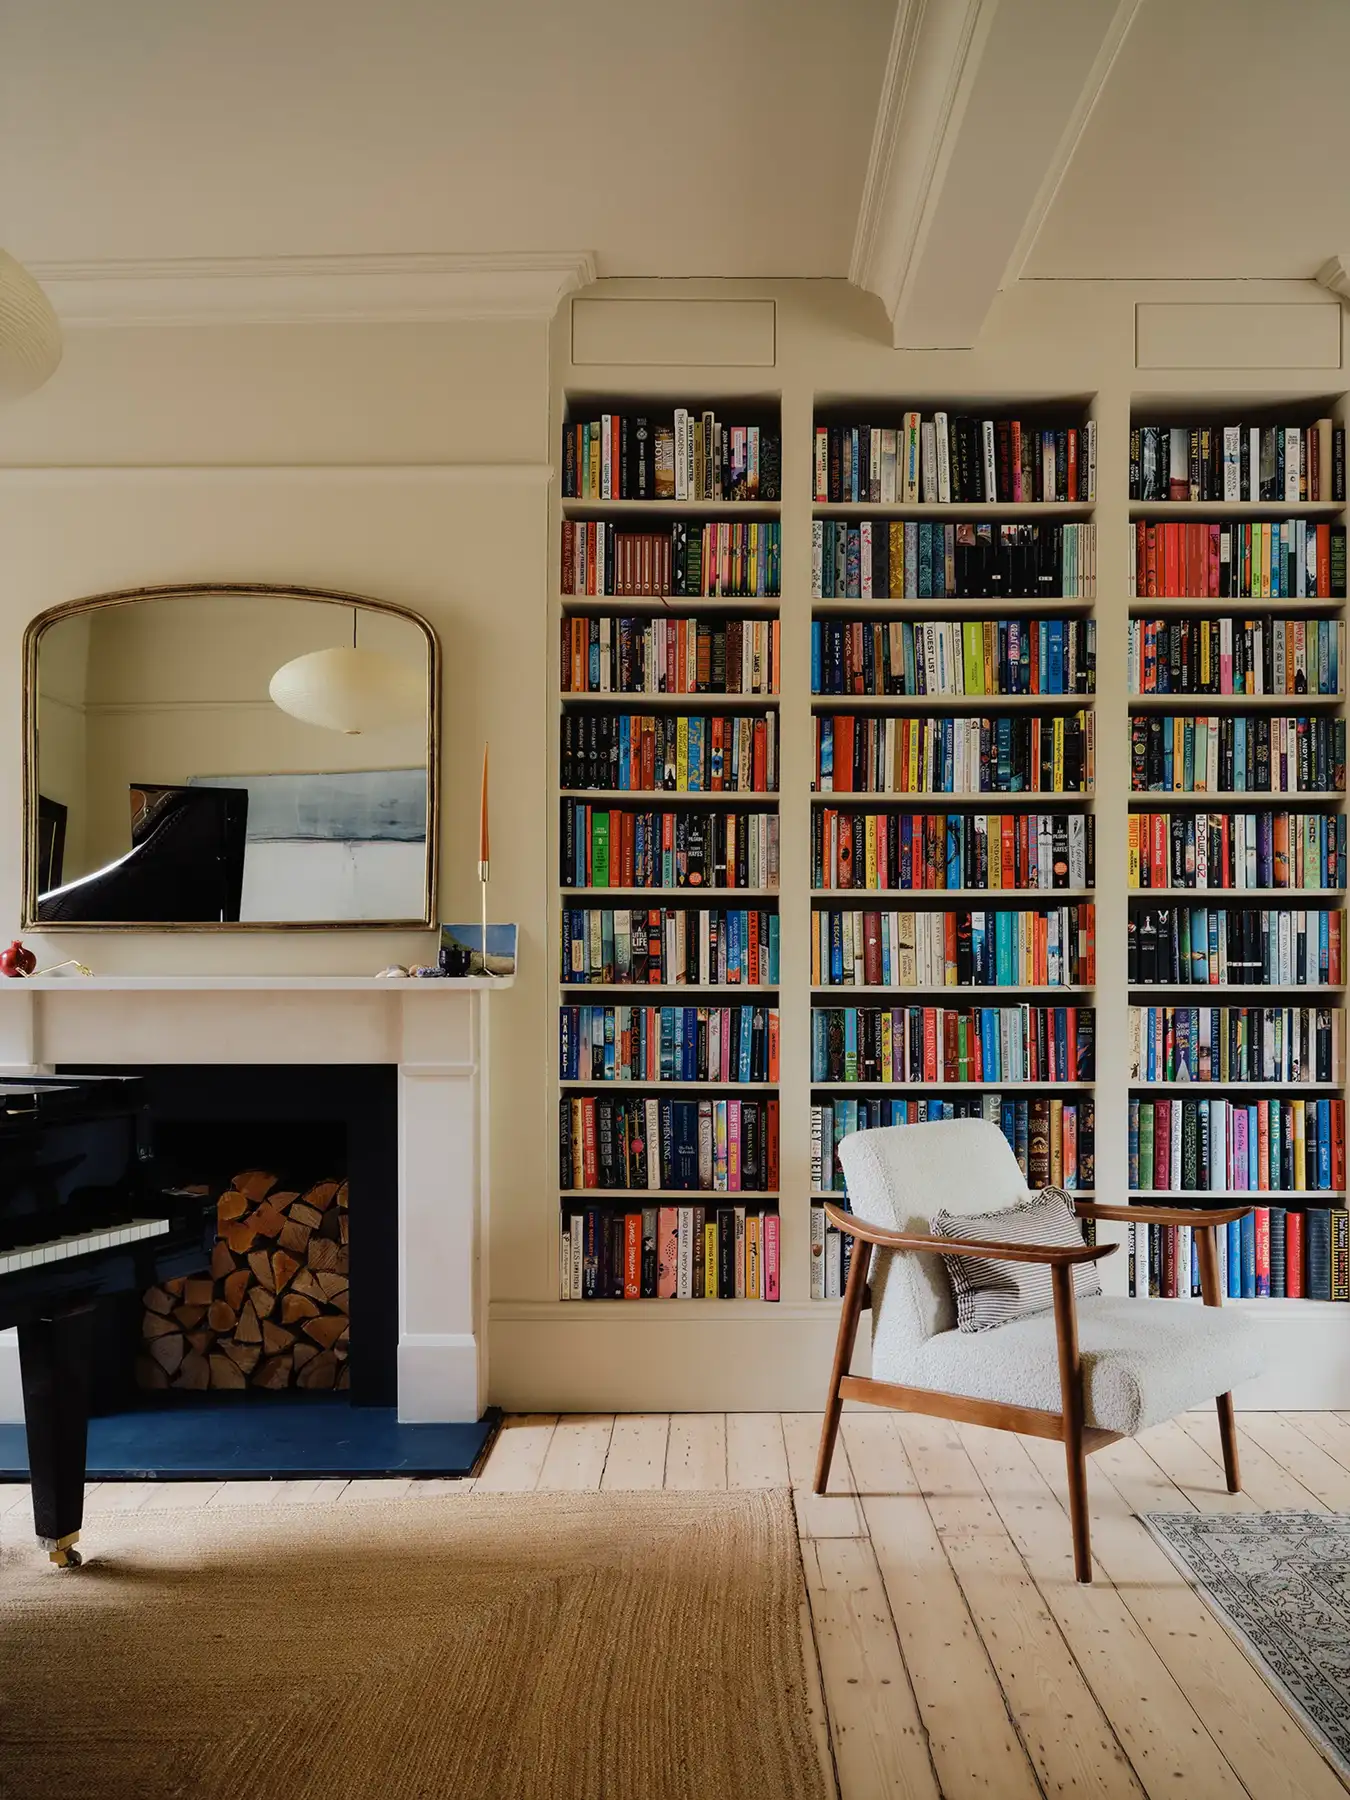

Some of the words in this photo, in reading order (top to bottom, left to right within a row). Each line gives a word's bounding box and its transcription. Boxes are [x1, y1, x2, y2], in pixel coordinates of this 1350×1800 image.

[1010, 624, 1018, 643] GREAT
[1010, 645, 1018, 665] CIRCLE
[1130, 819, 1138, 847] HUNTED
[993, 838, 1001, 877] ENDGAME
[633, 938, 647, 948] LIFE
[1191, 1010, 1199, 1033] NORTH
[926, 1019, 936, 1065] PACHINKO
[1191, 1034, 1199, 1060] WOODS
[812, 1110, 822, 1142] KILEY
[812, 1156, 822, 1182] REID
[769, 1221, 777, 1240] HELLO
[769, 1242, 777, 1274] BEAUTIFUL
